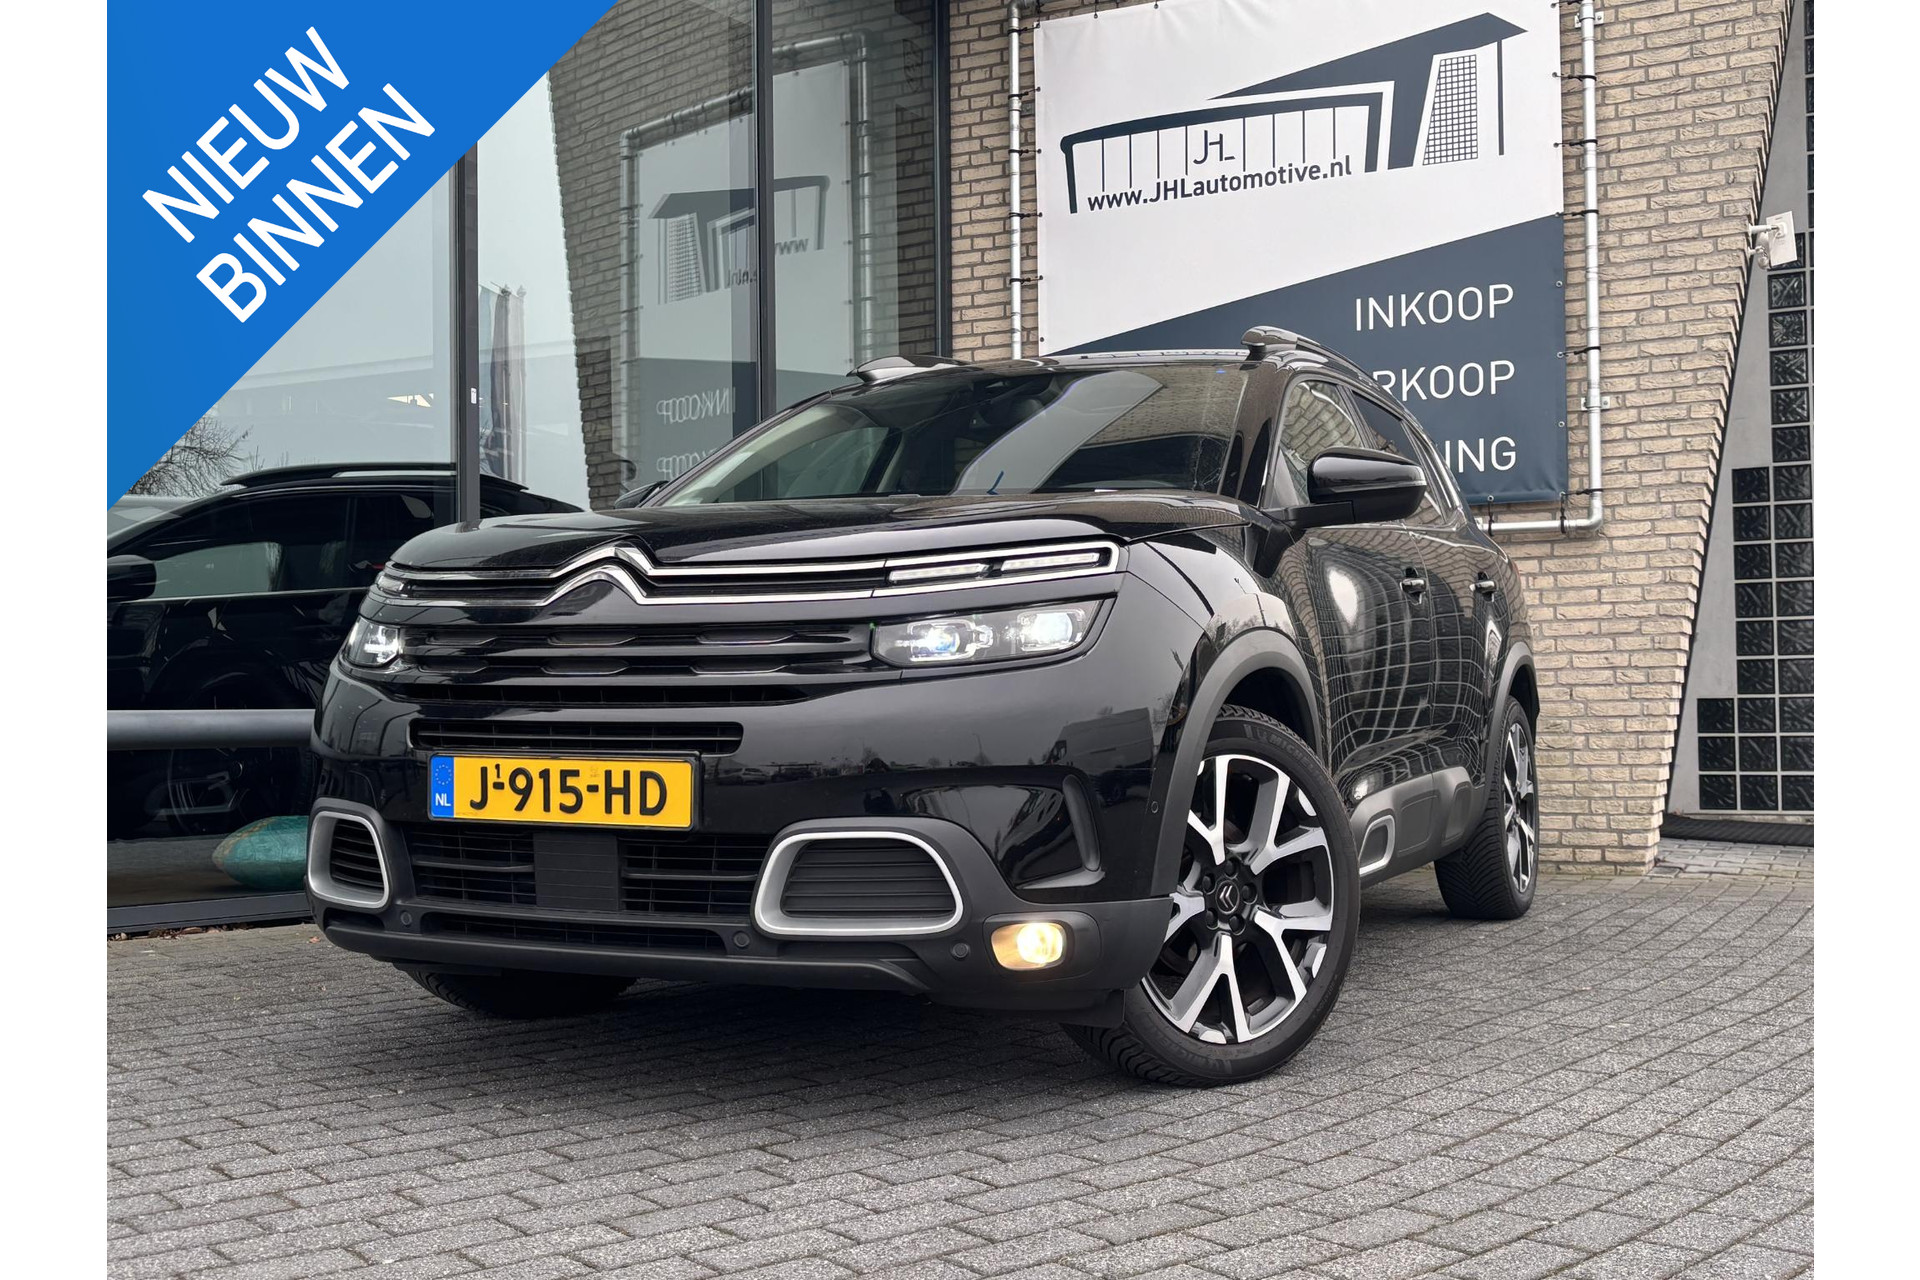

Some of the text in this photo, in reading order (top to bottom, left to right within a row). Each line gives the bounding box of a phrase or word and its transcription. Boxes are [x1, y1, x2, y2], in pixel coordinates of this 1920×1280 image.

[1088, 155, 1352, 211] www.JHLautomotive.nl
[1356, 284, 1514, 332] INKOOP
[1373, 360, 1516, 401] RKOOP
[1444, 437, 1517, 473] ING
[435, 793, 451, 806] NL
